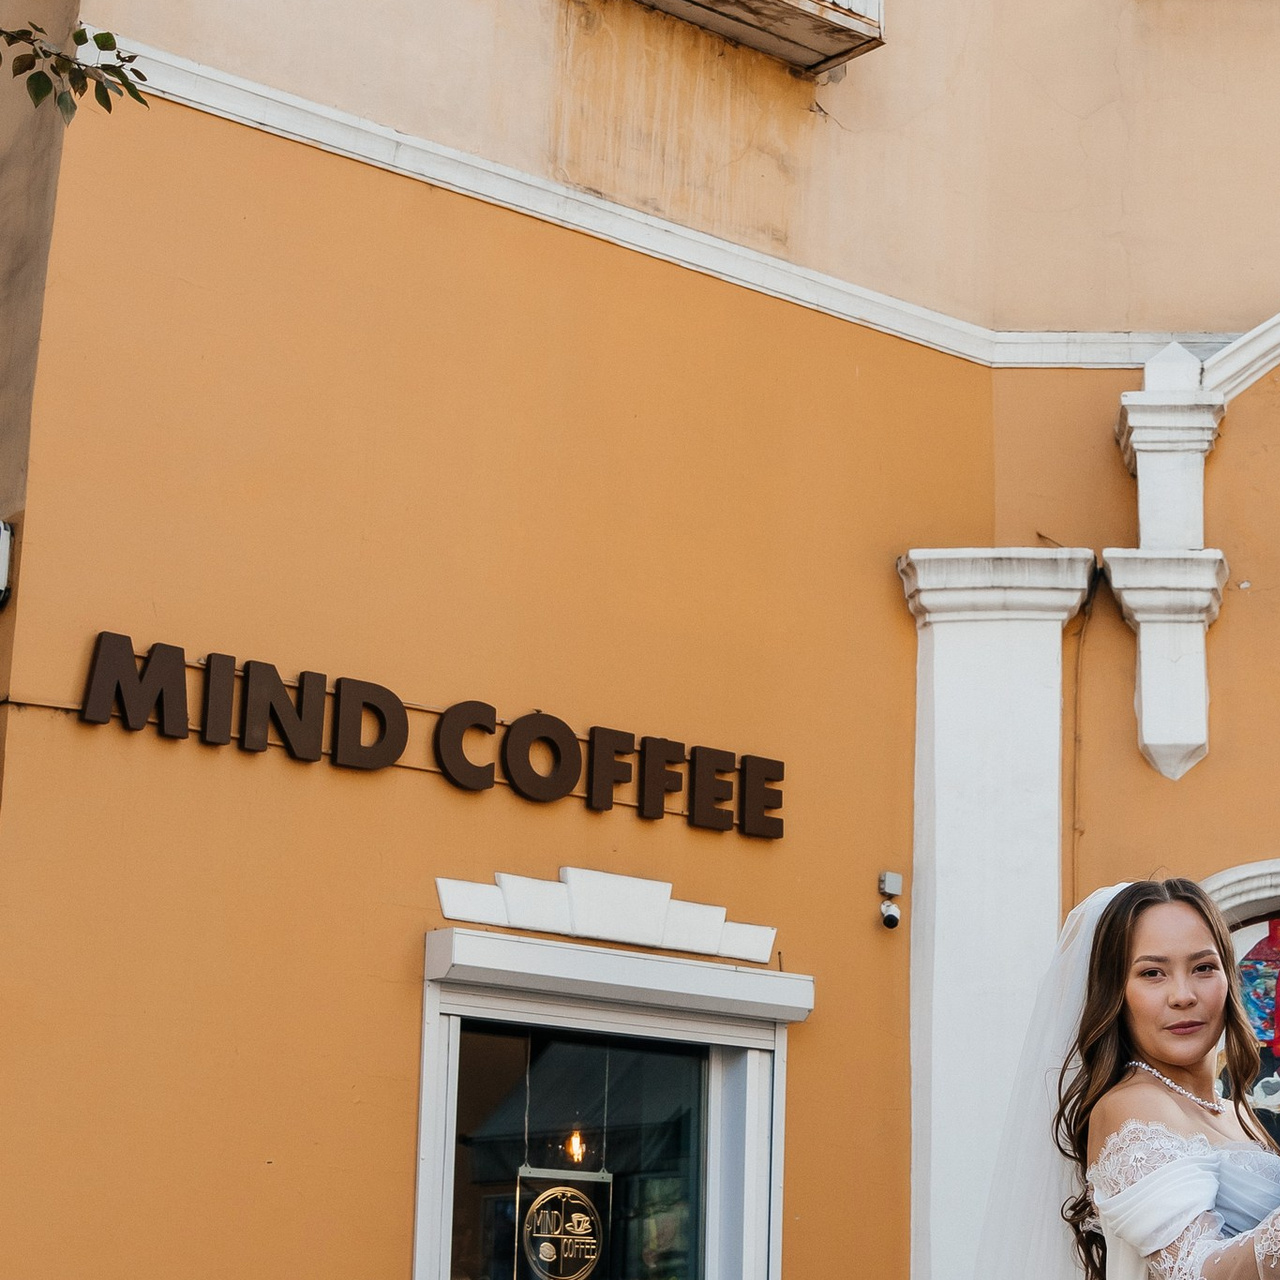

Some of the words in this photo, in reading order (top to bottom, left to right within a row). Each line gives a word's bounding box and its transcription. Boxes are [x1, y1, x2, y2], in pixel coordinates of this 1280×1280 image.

[82, 631, 409, 771] MIND
[434, 700, 784, 839] COFFEE
[533, 1210, 562, 1235] MIND
[563, 1239, 597, 1258] COFFEE
